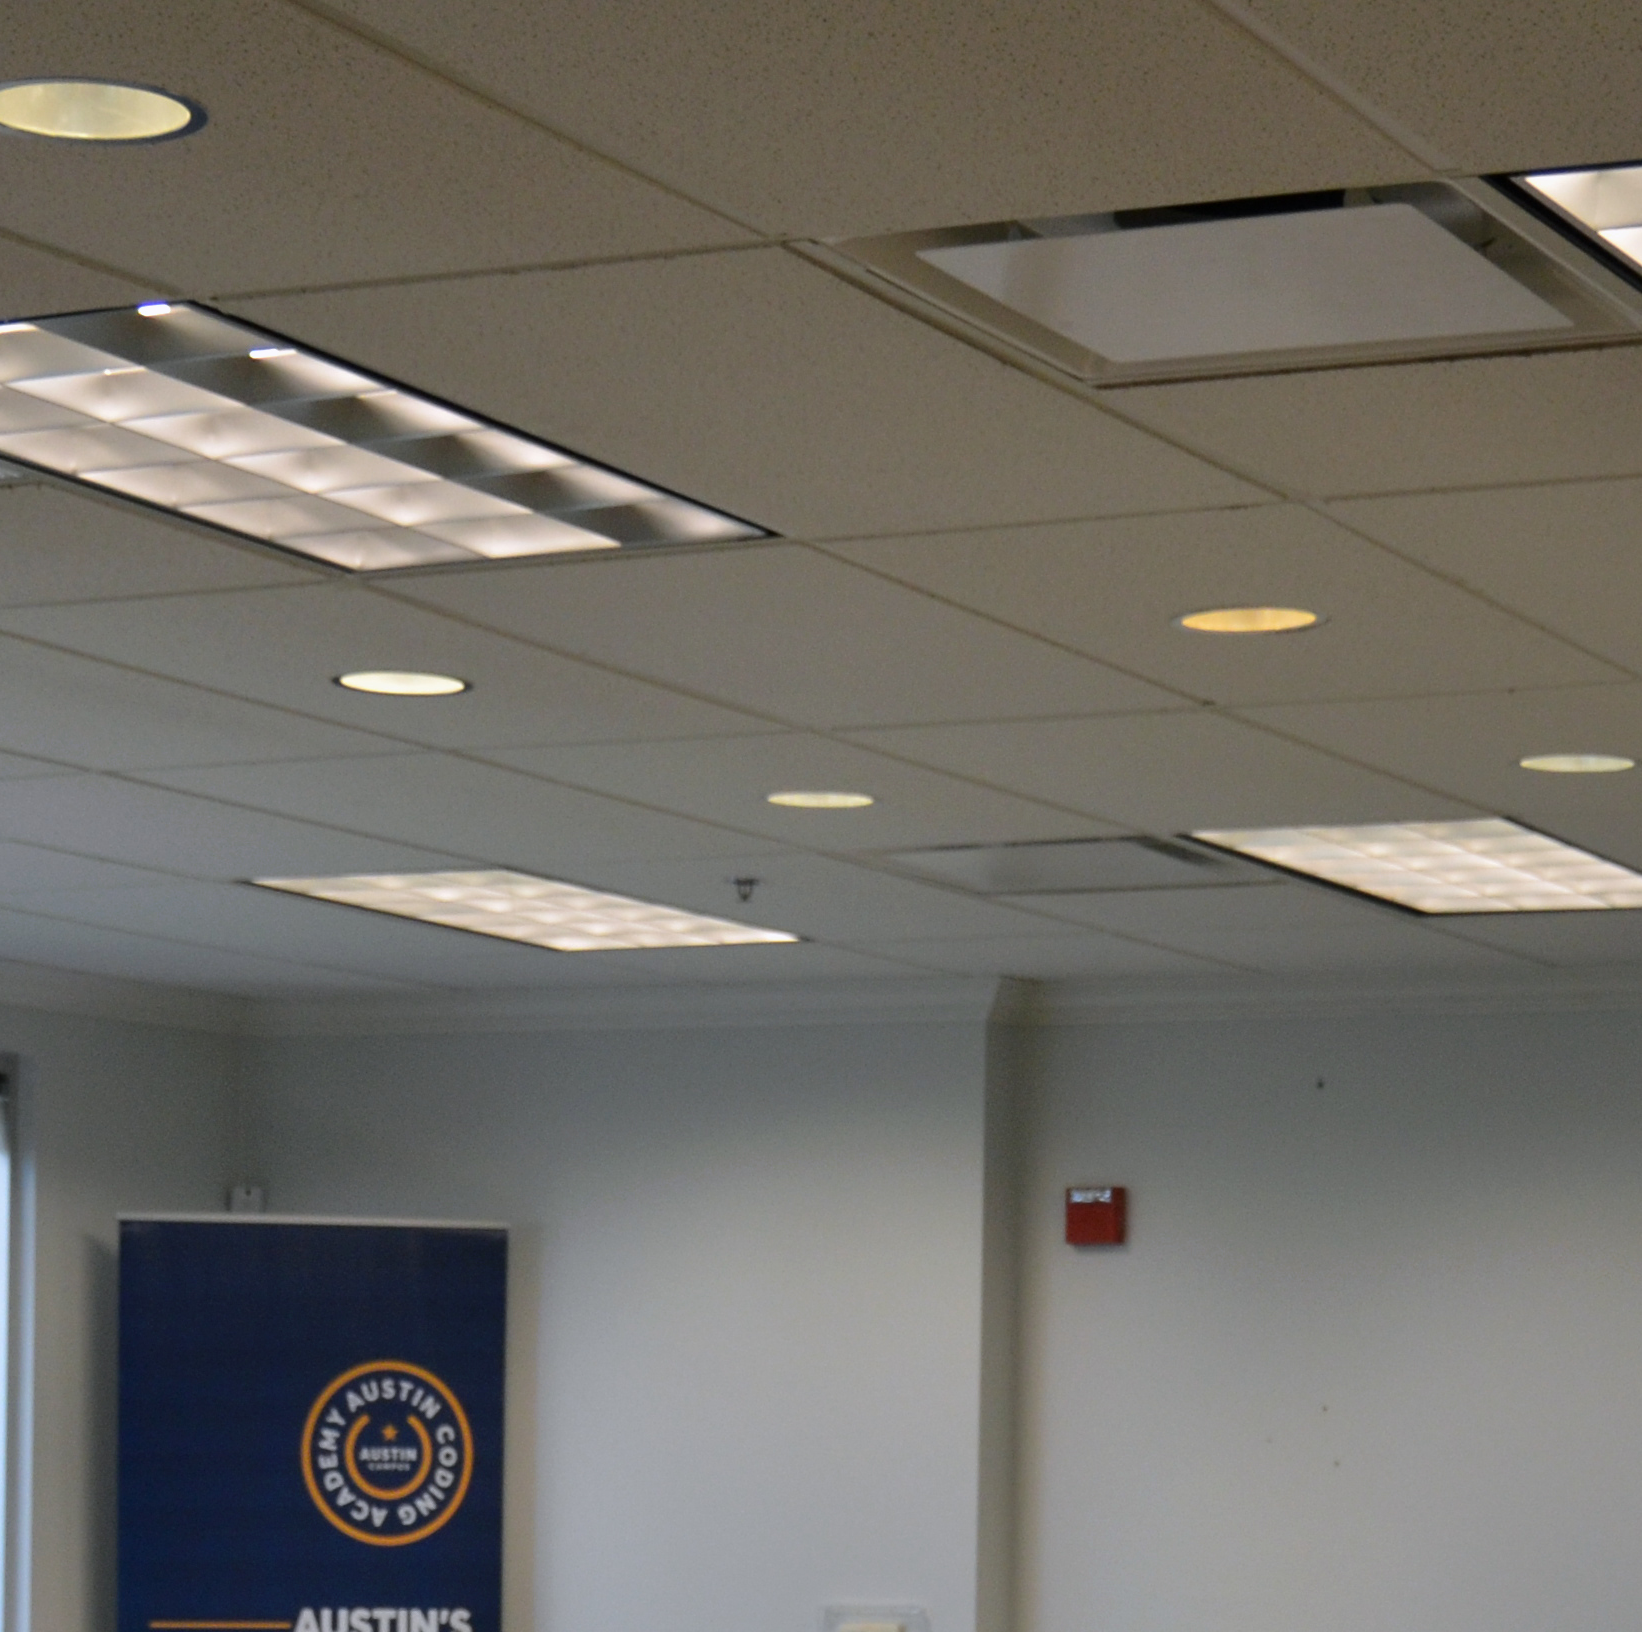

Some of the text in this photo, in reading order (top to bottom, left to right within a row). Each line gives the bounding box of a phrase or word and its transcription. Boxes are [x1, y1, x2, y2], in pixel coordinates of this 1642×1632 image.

[318, 1378, 458, 1527] AUSTIN CODING ACADEMY
[359, 1447, 417, 1461] AUSTIN
